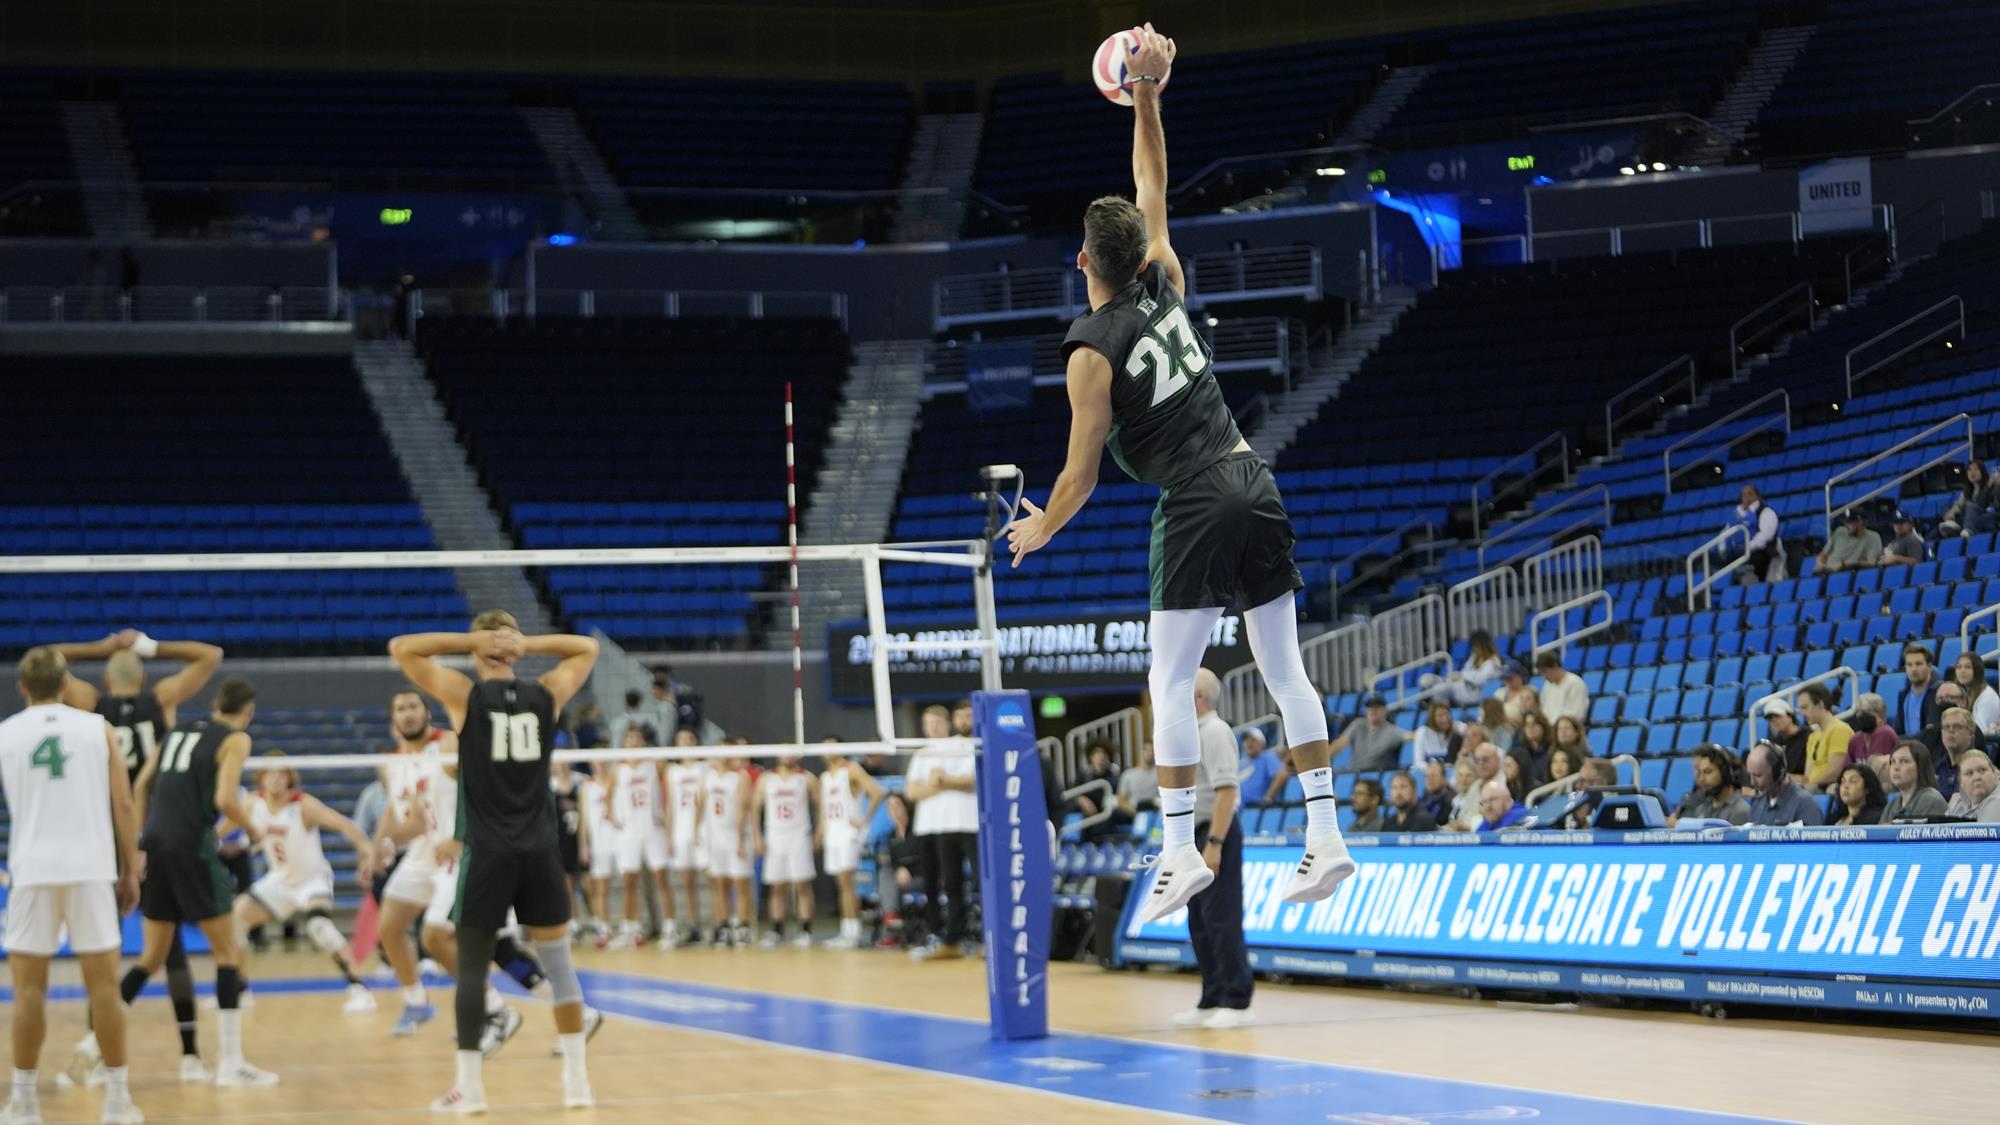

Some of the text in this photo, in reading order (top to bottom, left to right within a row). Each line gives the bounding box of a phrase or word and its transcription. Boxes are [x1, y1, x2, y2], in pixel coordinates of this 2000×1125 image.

[1808, 181, 1861, 200] UNITED
[1125, 302, 1208, 409] 23
[994, 622, 1098, 657] NATIONAL
[1103, 615, 1240, 651] COLTE
[31, 736, 68, 779] 4
[161, 731, 202, 773] 11
[489, 711, 542, 762] 10
[1896, 827, 1921, 841] AULEY
[1004, 750, 1030, 1007] VOLLEYBALL
[1449, 863, 1667, 948] COLLEGIATE
[1656, 863, 1921, 956] VOLLEYBALL
[1760, 984, 1789, 998] presented
[1797, 985, 1825, 1001] WESCOM
